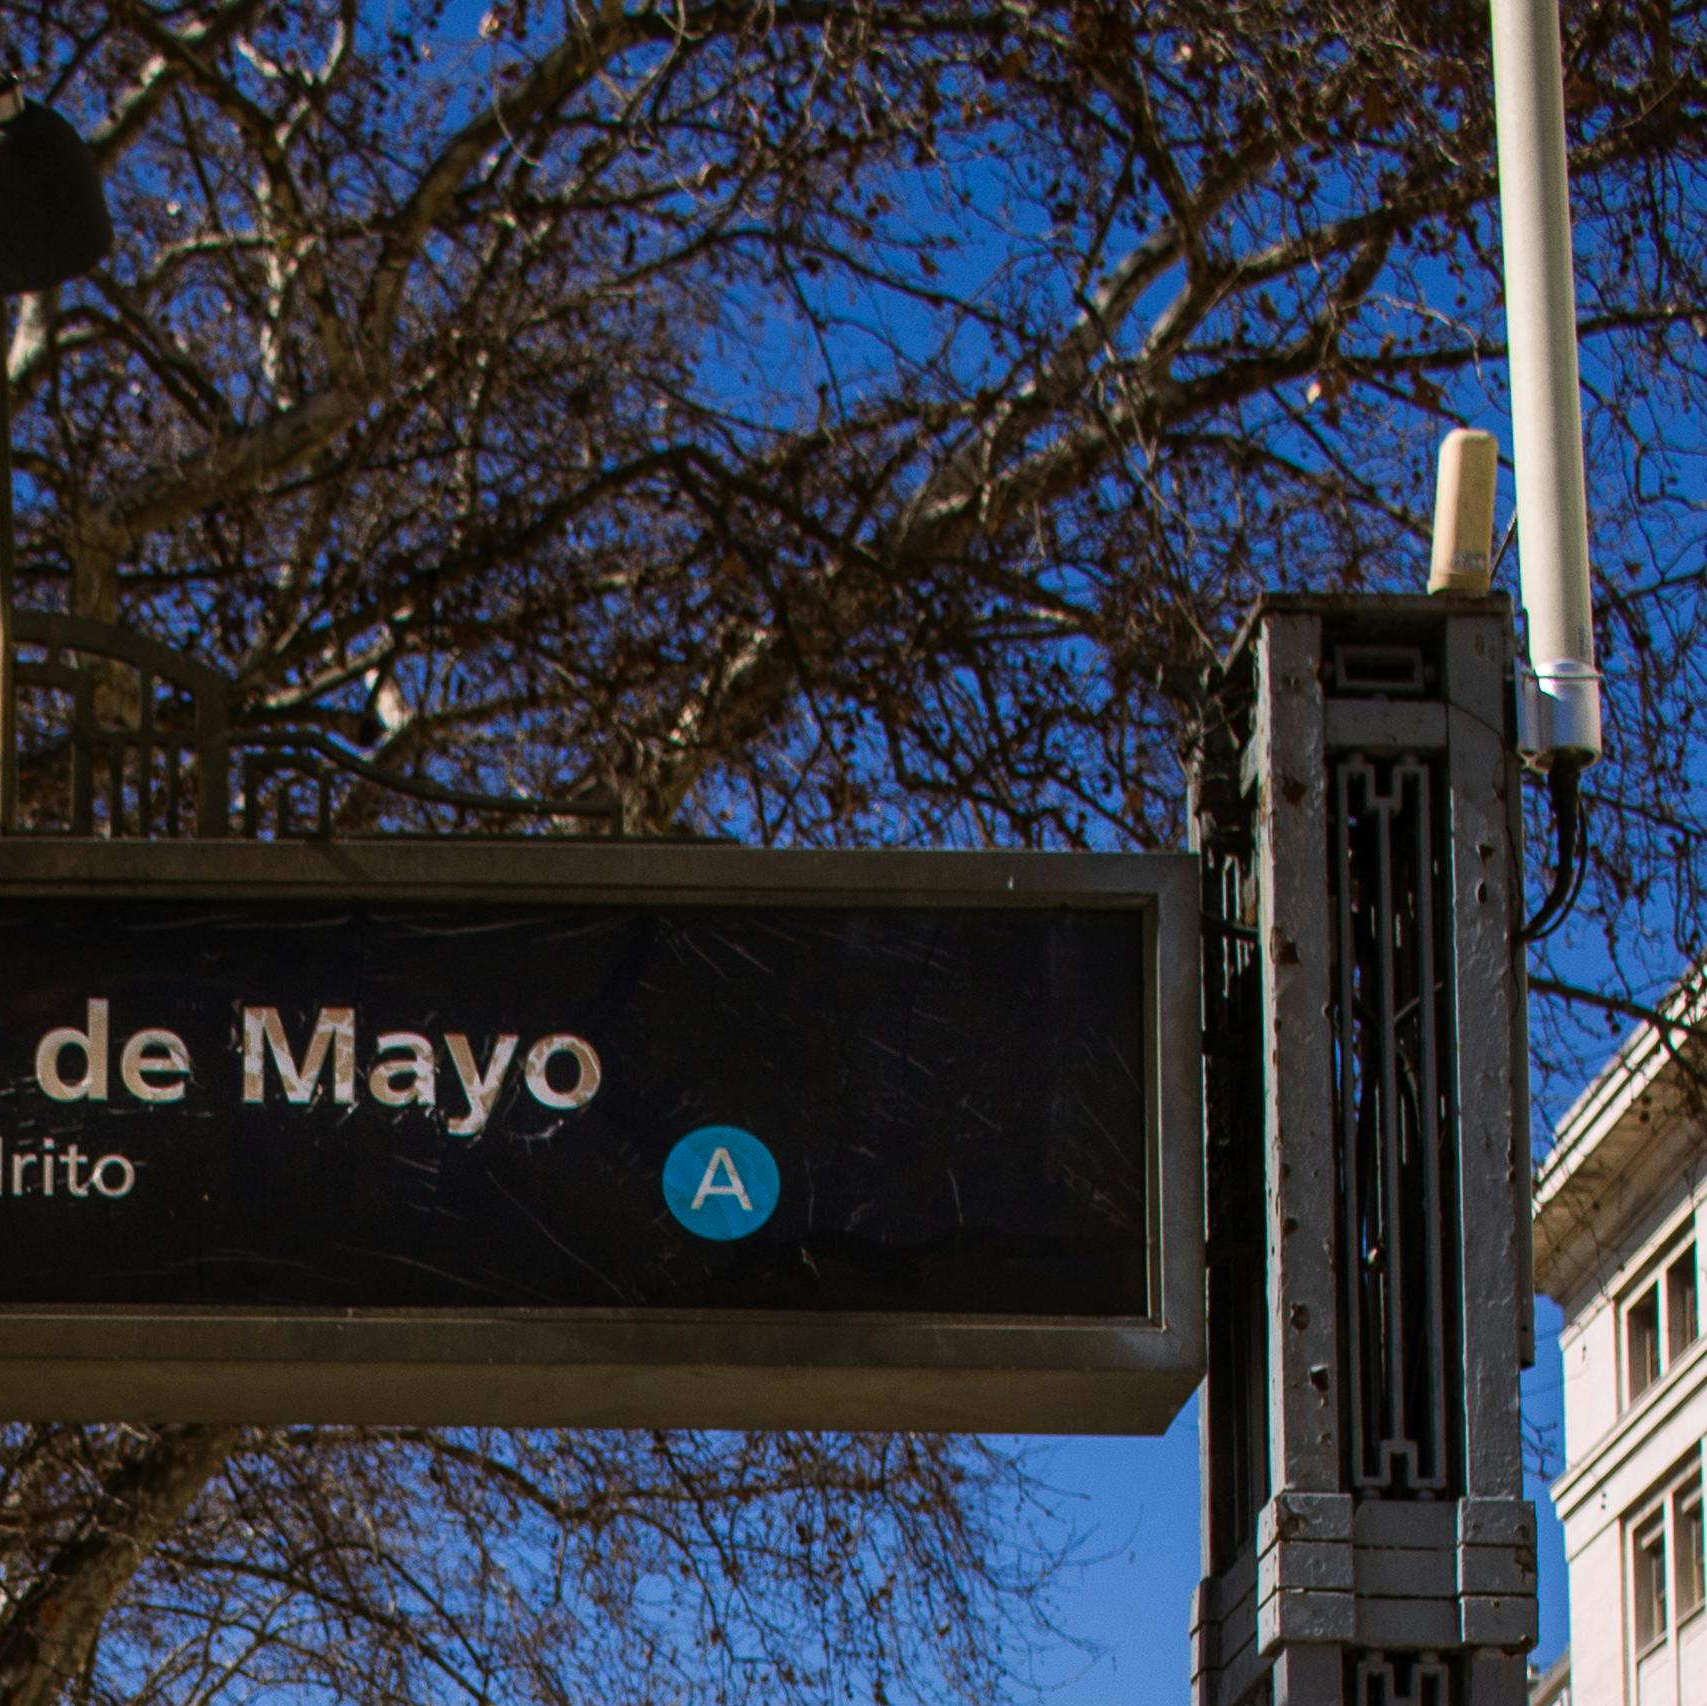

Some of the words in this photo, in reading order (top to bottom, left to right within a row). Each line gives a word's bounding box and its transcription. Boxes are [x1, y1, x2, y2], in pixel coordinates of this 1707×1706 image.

[34, 998, 190, 1102] de
[242, 1005, 602, 1137] Mayo
[691, 1147, 753, 1211] A
